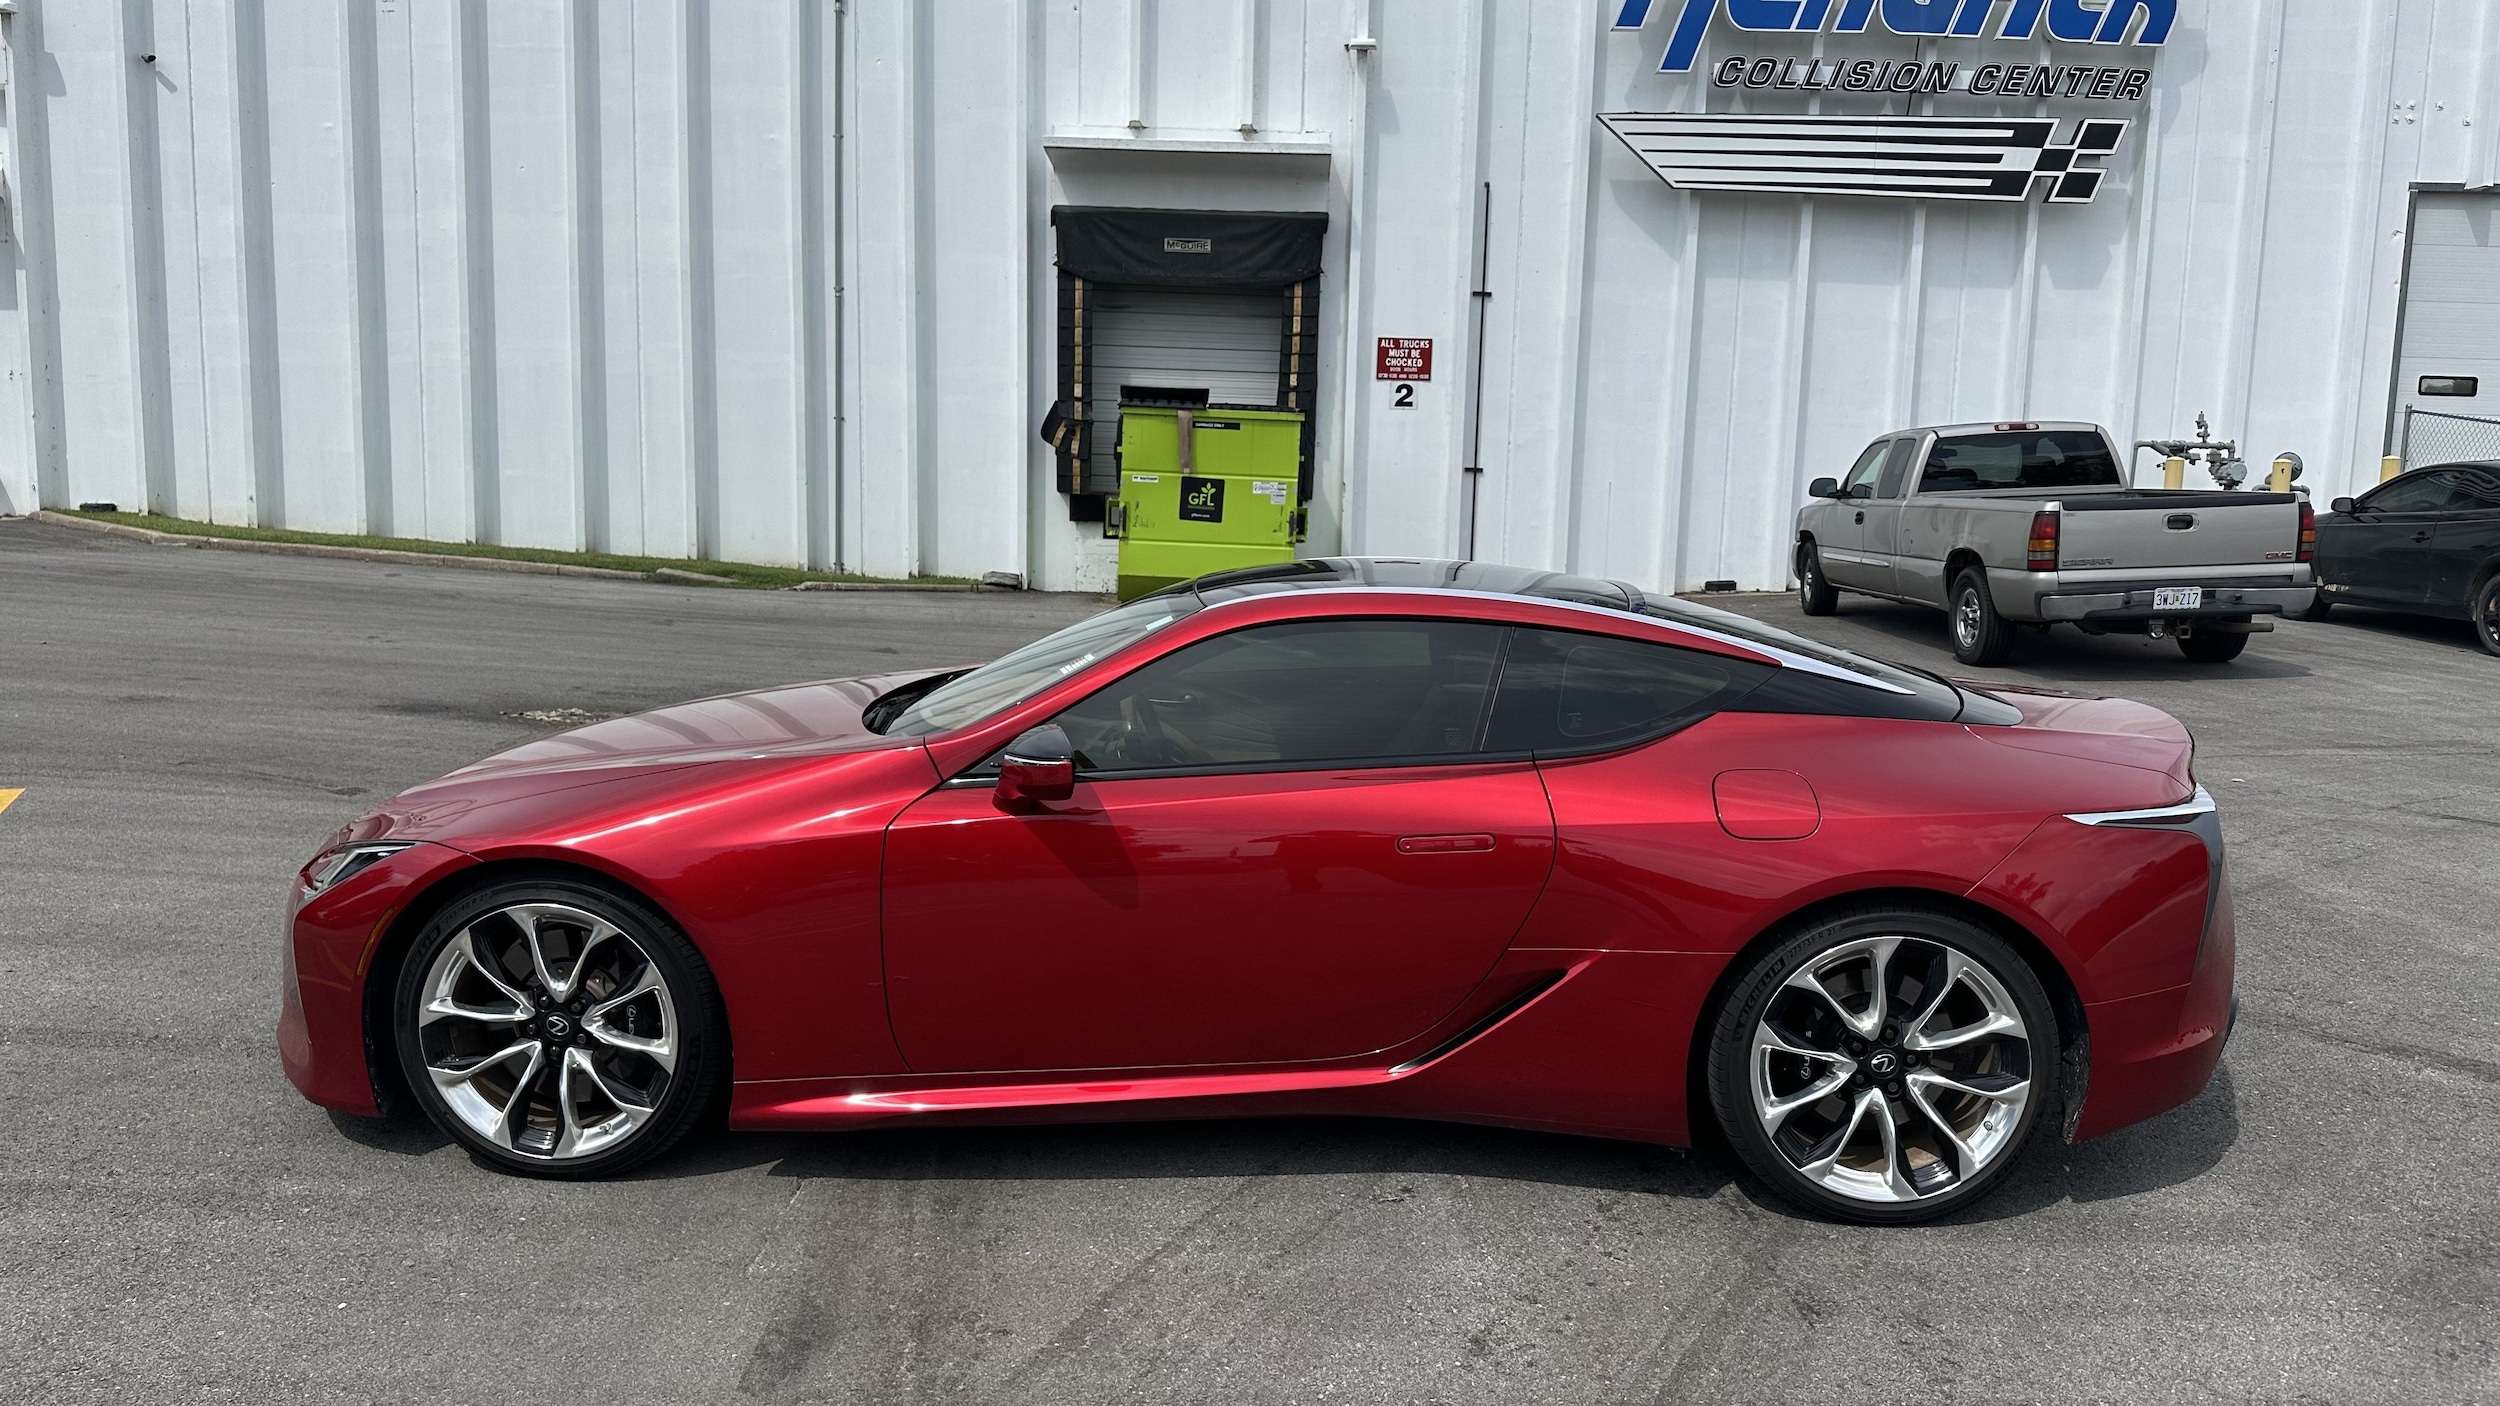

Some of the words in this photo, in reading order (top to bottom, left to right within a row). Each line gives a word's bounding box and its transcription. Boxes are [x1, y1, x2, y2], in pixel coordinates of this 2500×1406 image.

[1715, 55, 1961, 93] COLLISION
[1969, 61, 2152, 101] CENTER
[1380, 339, 1395, 348] ALL
[1399, 340, 1430, 349] TRUCKS
[1388, 349, 1409, 358] MUST
[1410, 349, 1421, 358] BE
[1385, 358, 1423, 367] CHOCKED
[1394, 384, 1414, 407] 2
[1188, 491, 1215, 506] GFL
[2265, 550, 2293, 560] GMC
[2062, 558, 2113, 567] SIERRA
